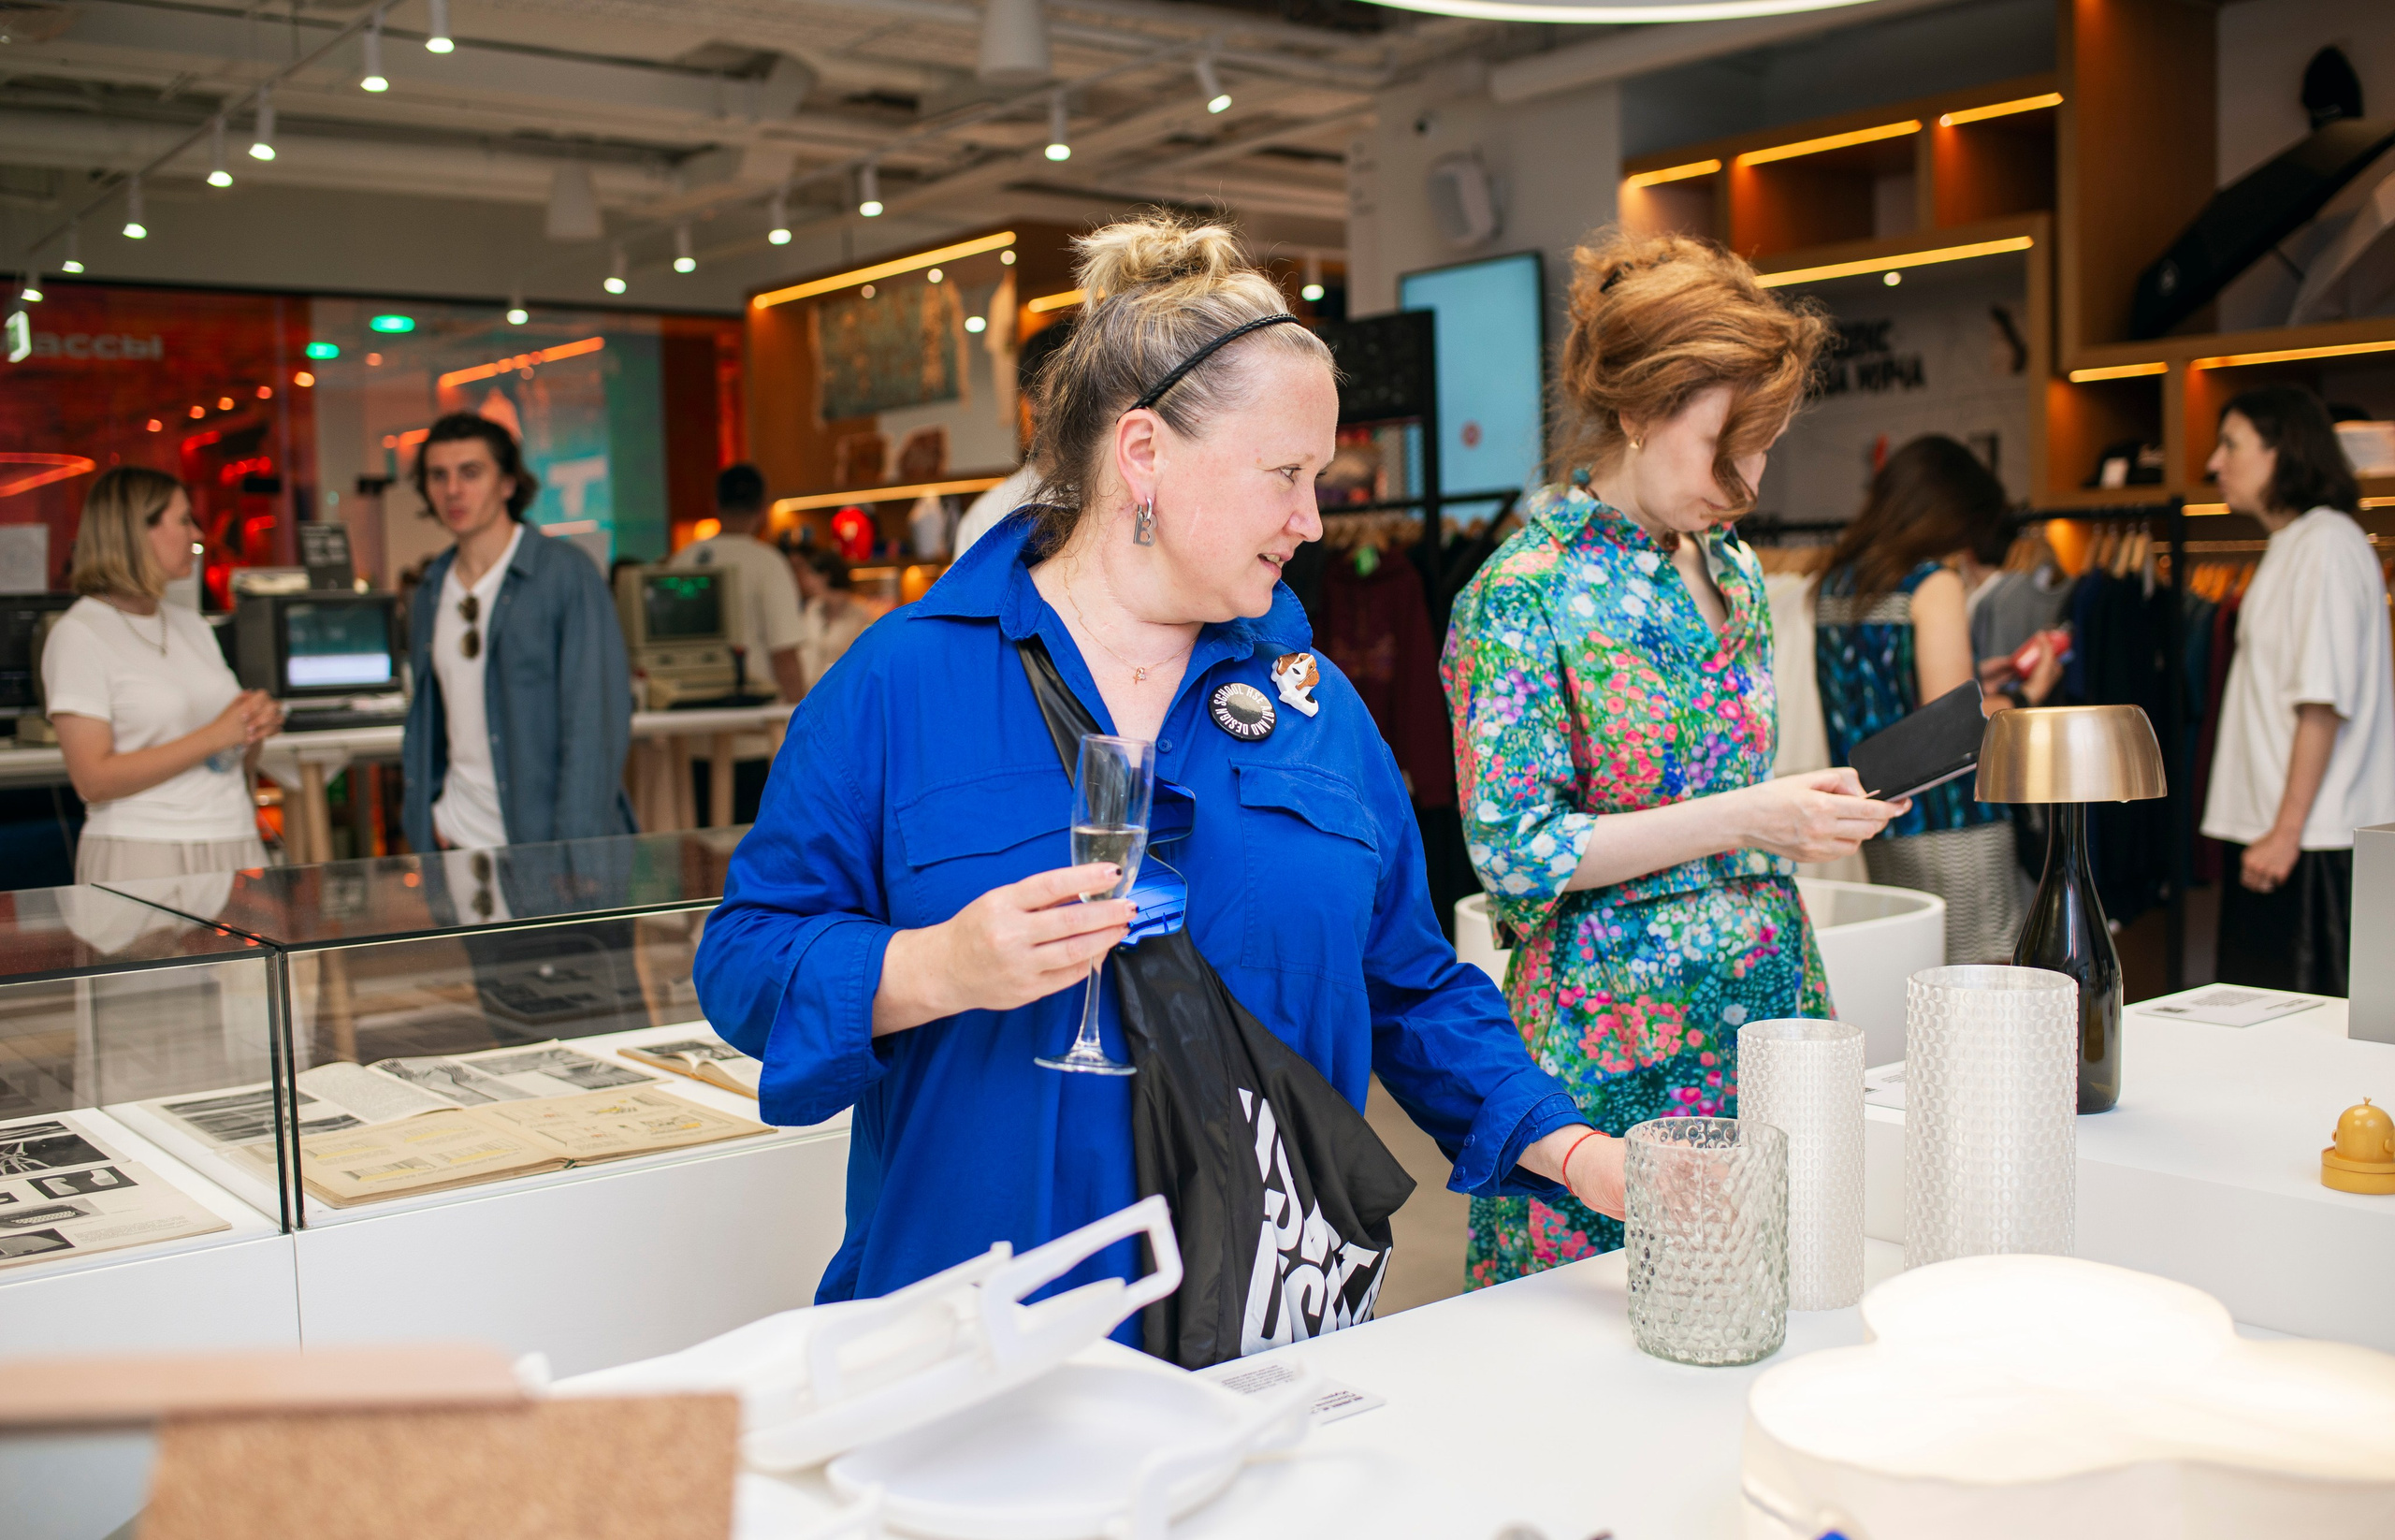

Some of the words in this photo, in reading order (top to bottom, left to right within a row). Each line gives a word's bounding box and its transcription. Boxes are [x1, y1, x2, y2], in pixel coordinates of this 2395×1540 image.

[4, 331, 165, 361] ассы
[1213, 684, 1243, 706] SCHOOL
[1246, 688, 1267, 705] HSE
[1215, 707, 1249, 735] DESIGN
[1260, 705, 1275, 724] ART
[1251, 719, 1271, 735] AND
